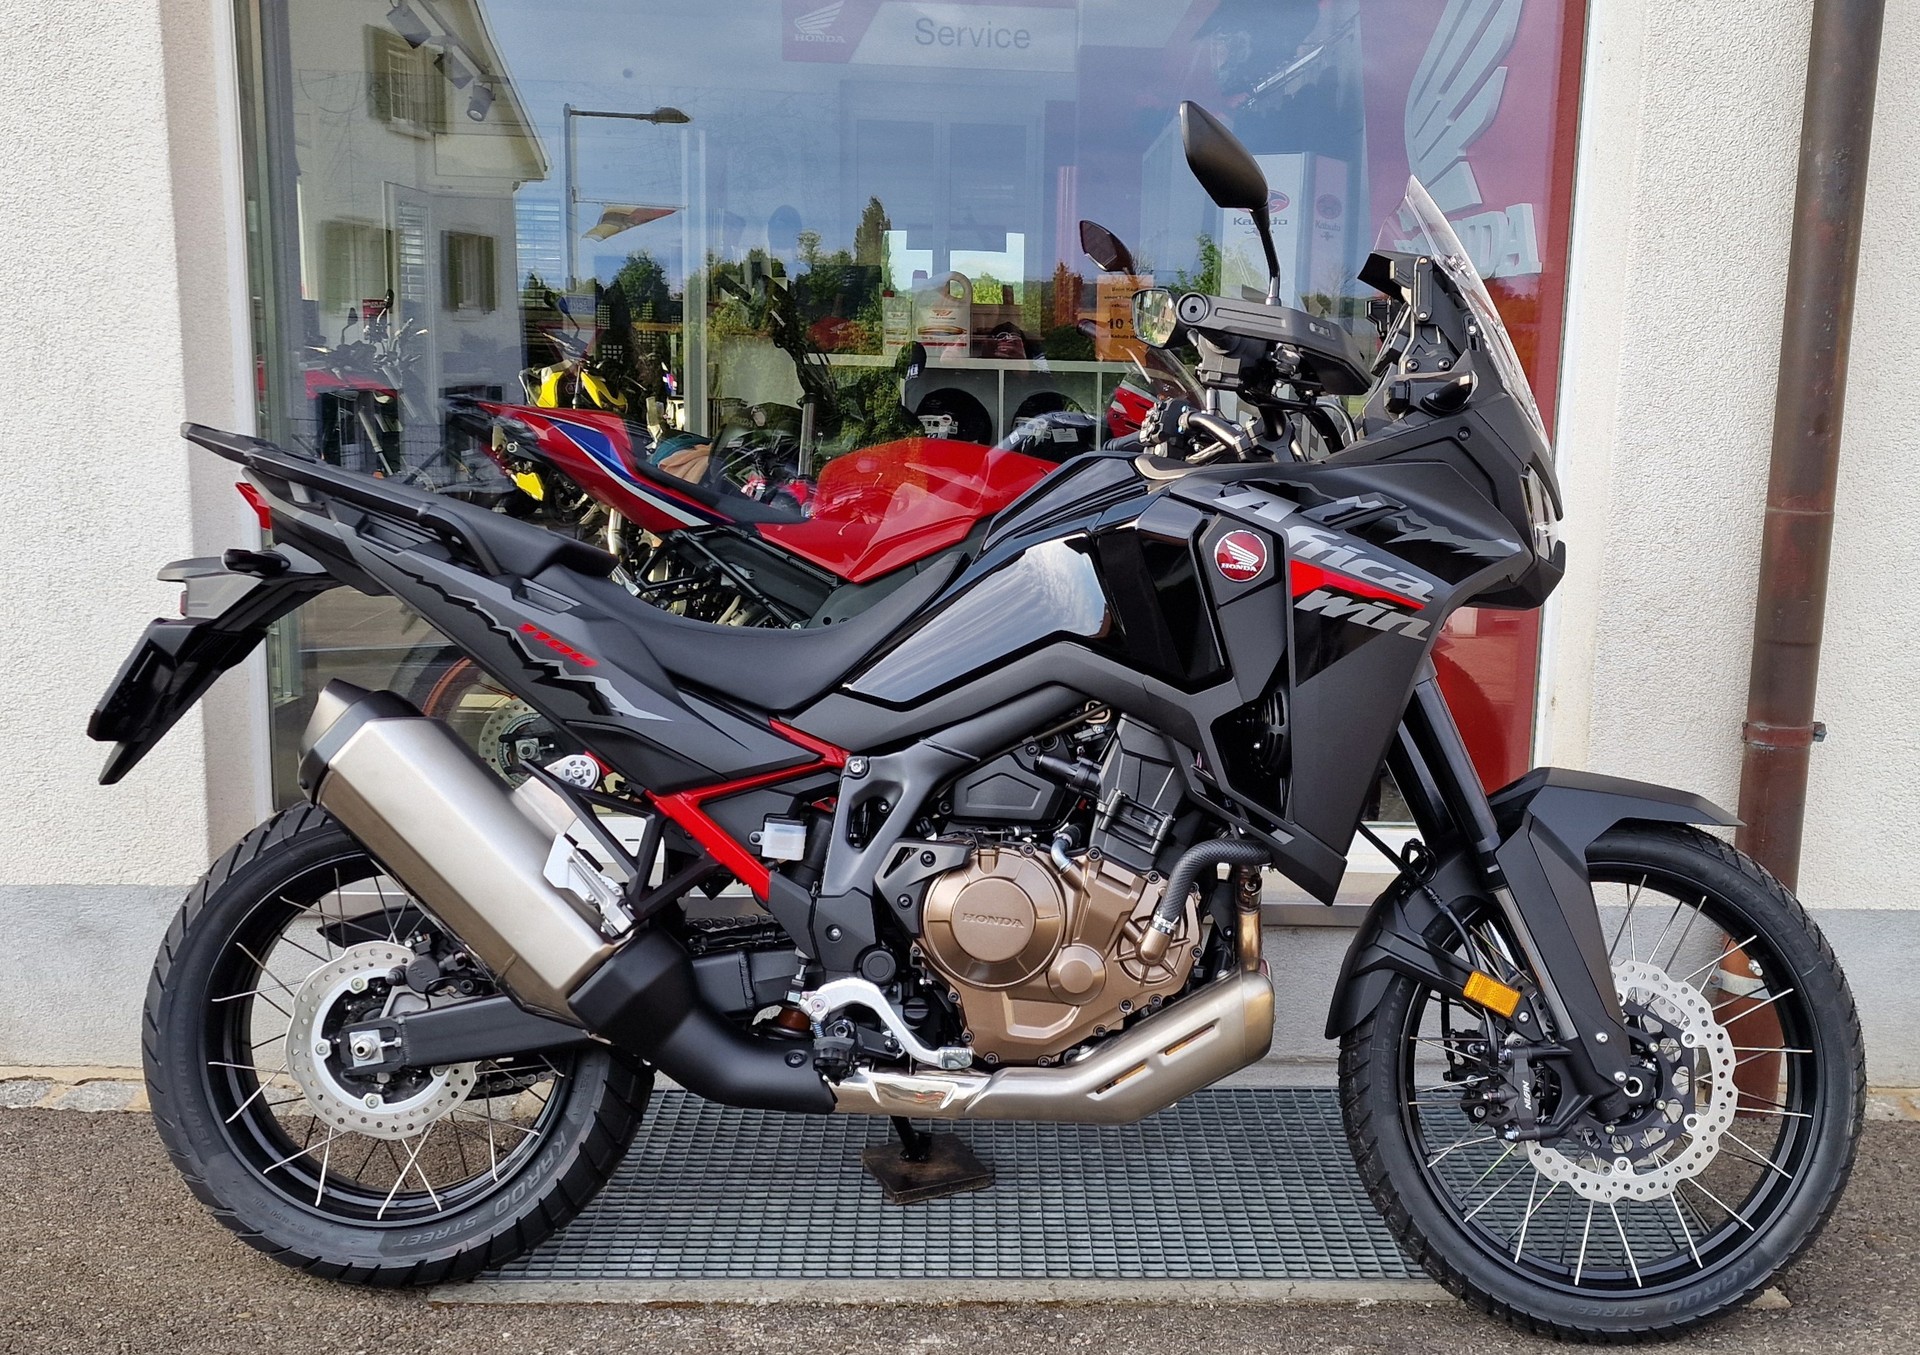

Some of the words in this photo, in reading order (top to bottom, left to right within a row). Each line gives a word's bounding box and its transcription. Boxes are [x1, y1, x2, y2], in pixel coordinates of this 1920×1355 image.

[795, 33, 847, 44] HONDA
[914, 17, 1032, 49] Service
[1107, 318, 1124, 329] 10
[1214, 491, 1435, 603] Africa
[1220, 562, 1258, 572] HONDA
[519, 623, 598, 668] 1100
[962, 912, 1025, 929] HONDA
[494, 1131, 568, 1217] KAROO
[394, 1213, 480, 1248] STREET
[1665, 1257, 1756, 1314] KAROO
